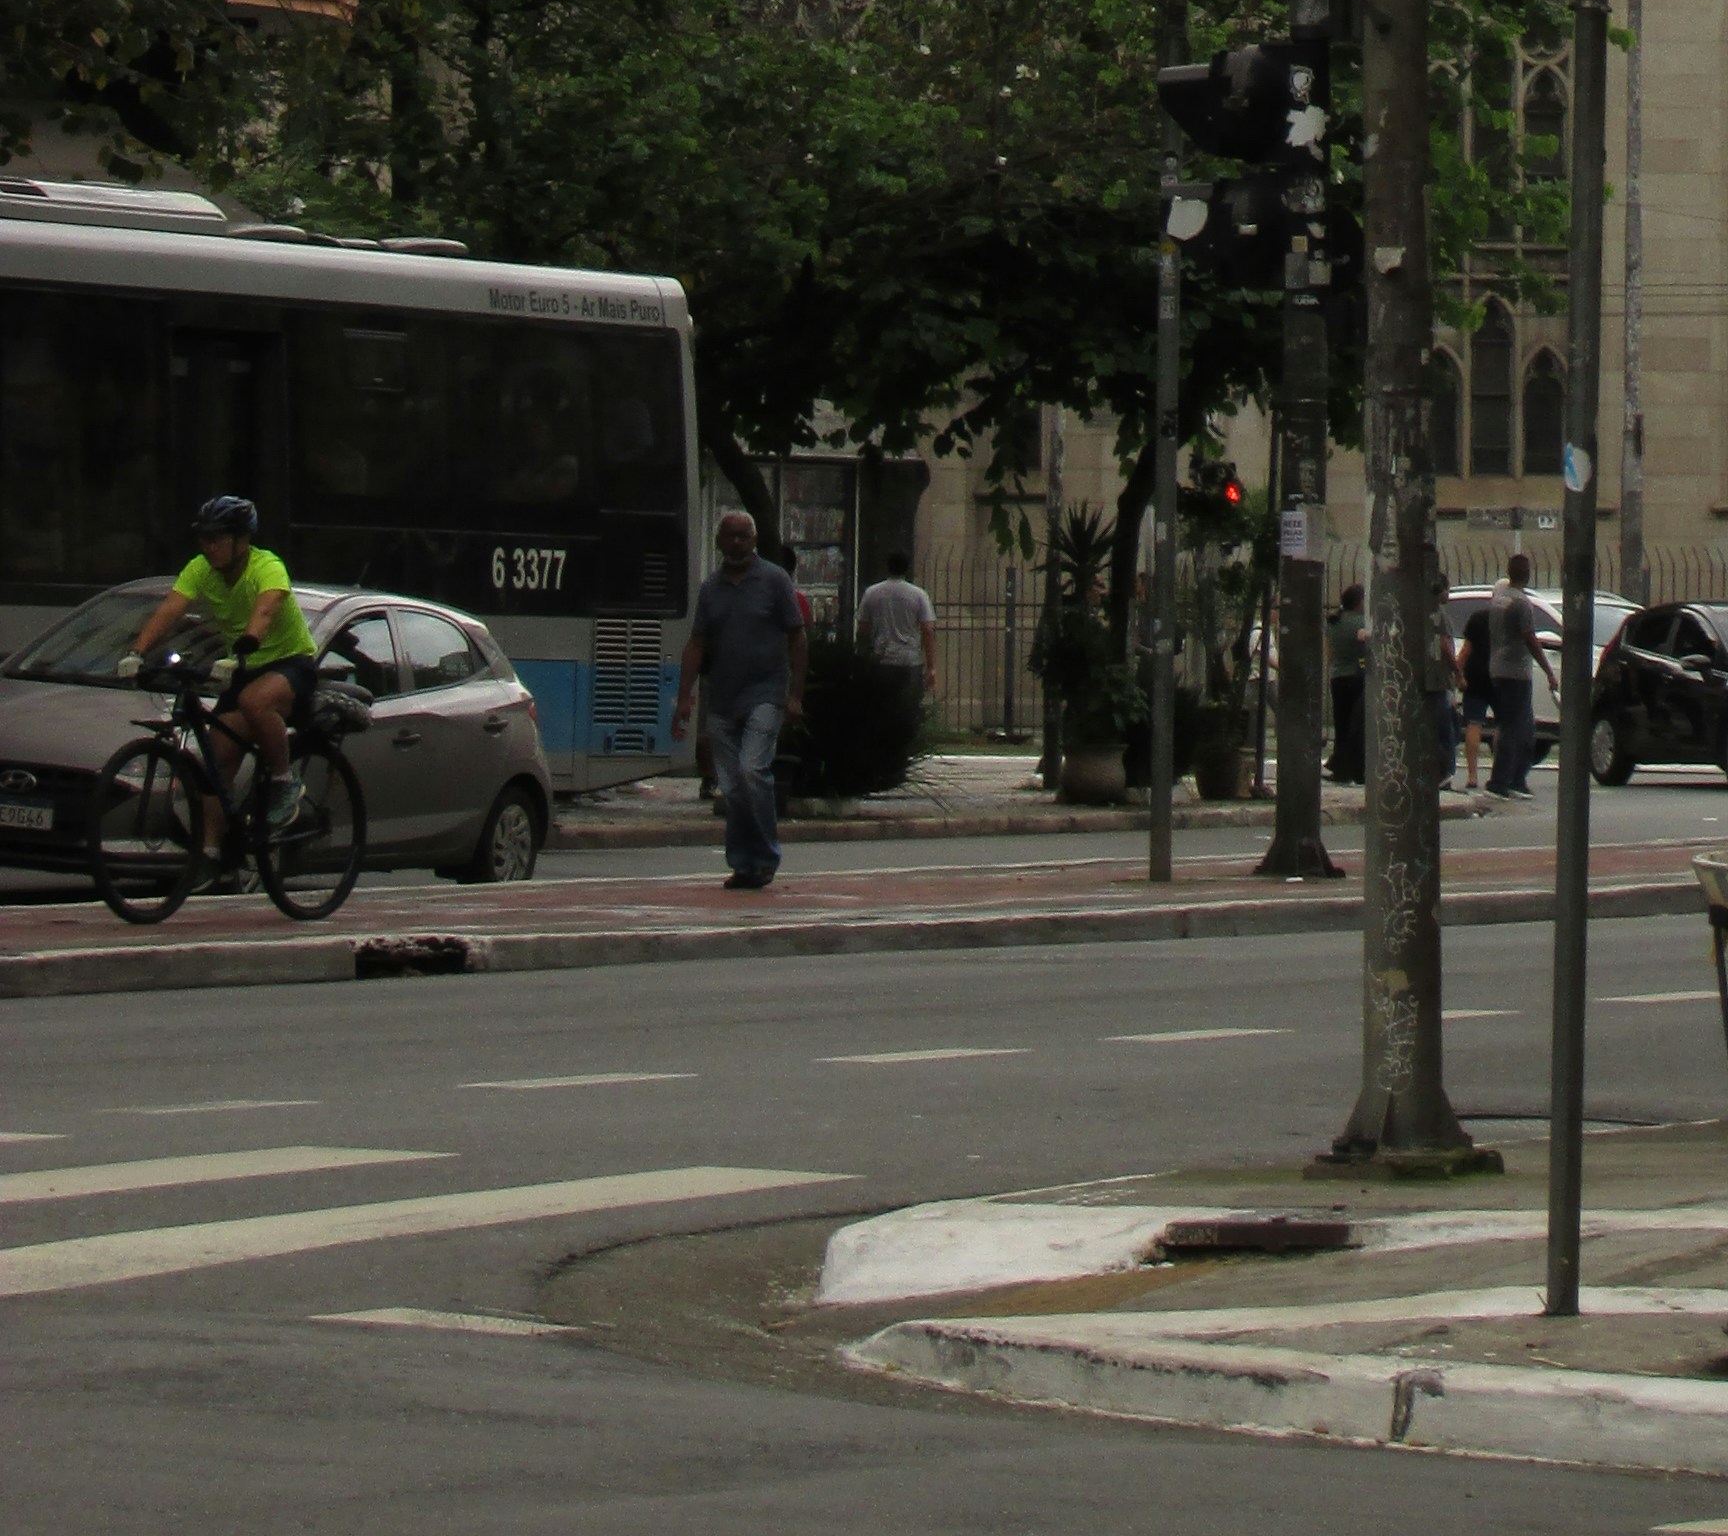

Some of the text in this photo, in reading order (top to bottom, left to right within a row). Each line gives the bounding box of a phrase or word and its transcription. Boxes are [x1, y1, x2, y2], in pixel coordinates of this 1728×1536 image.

[489, 288, 525, 311] Motor
[529, 291, 559, 313] Euro
[581, 295, 595, 317] Ar
[599, 297, 627, 319] Mais
[630, 299, 661, 321] Puro
[491, 546, 568, 590] 6 3377
